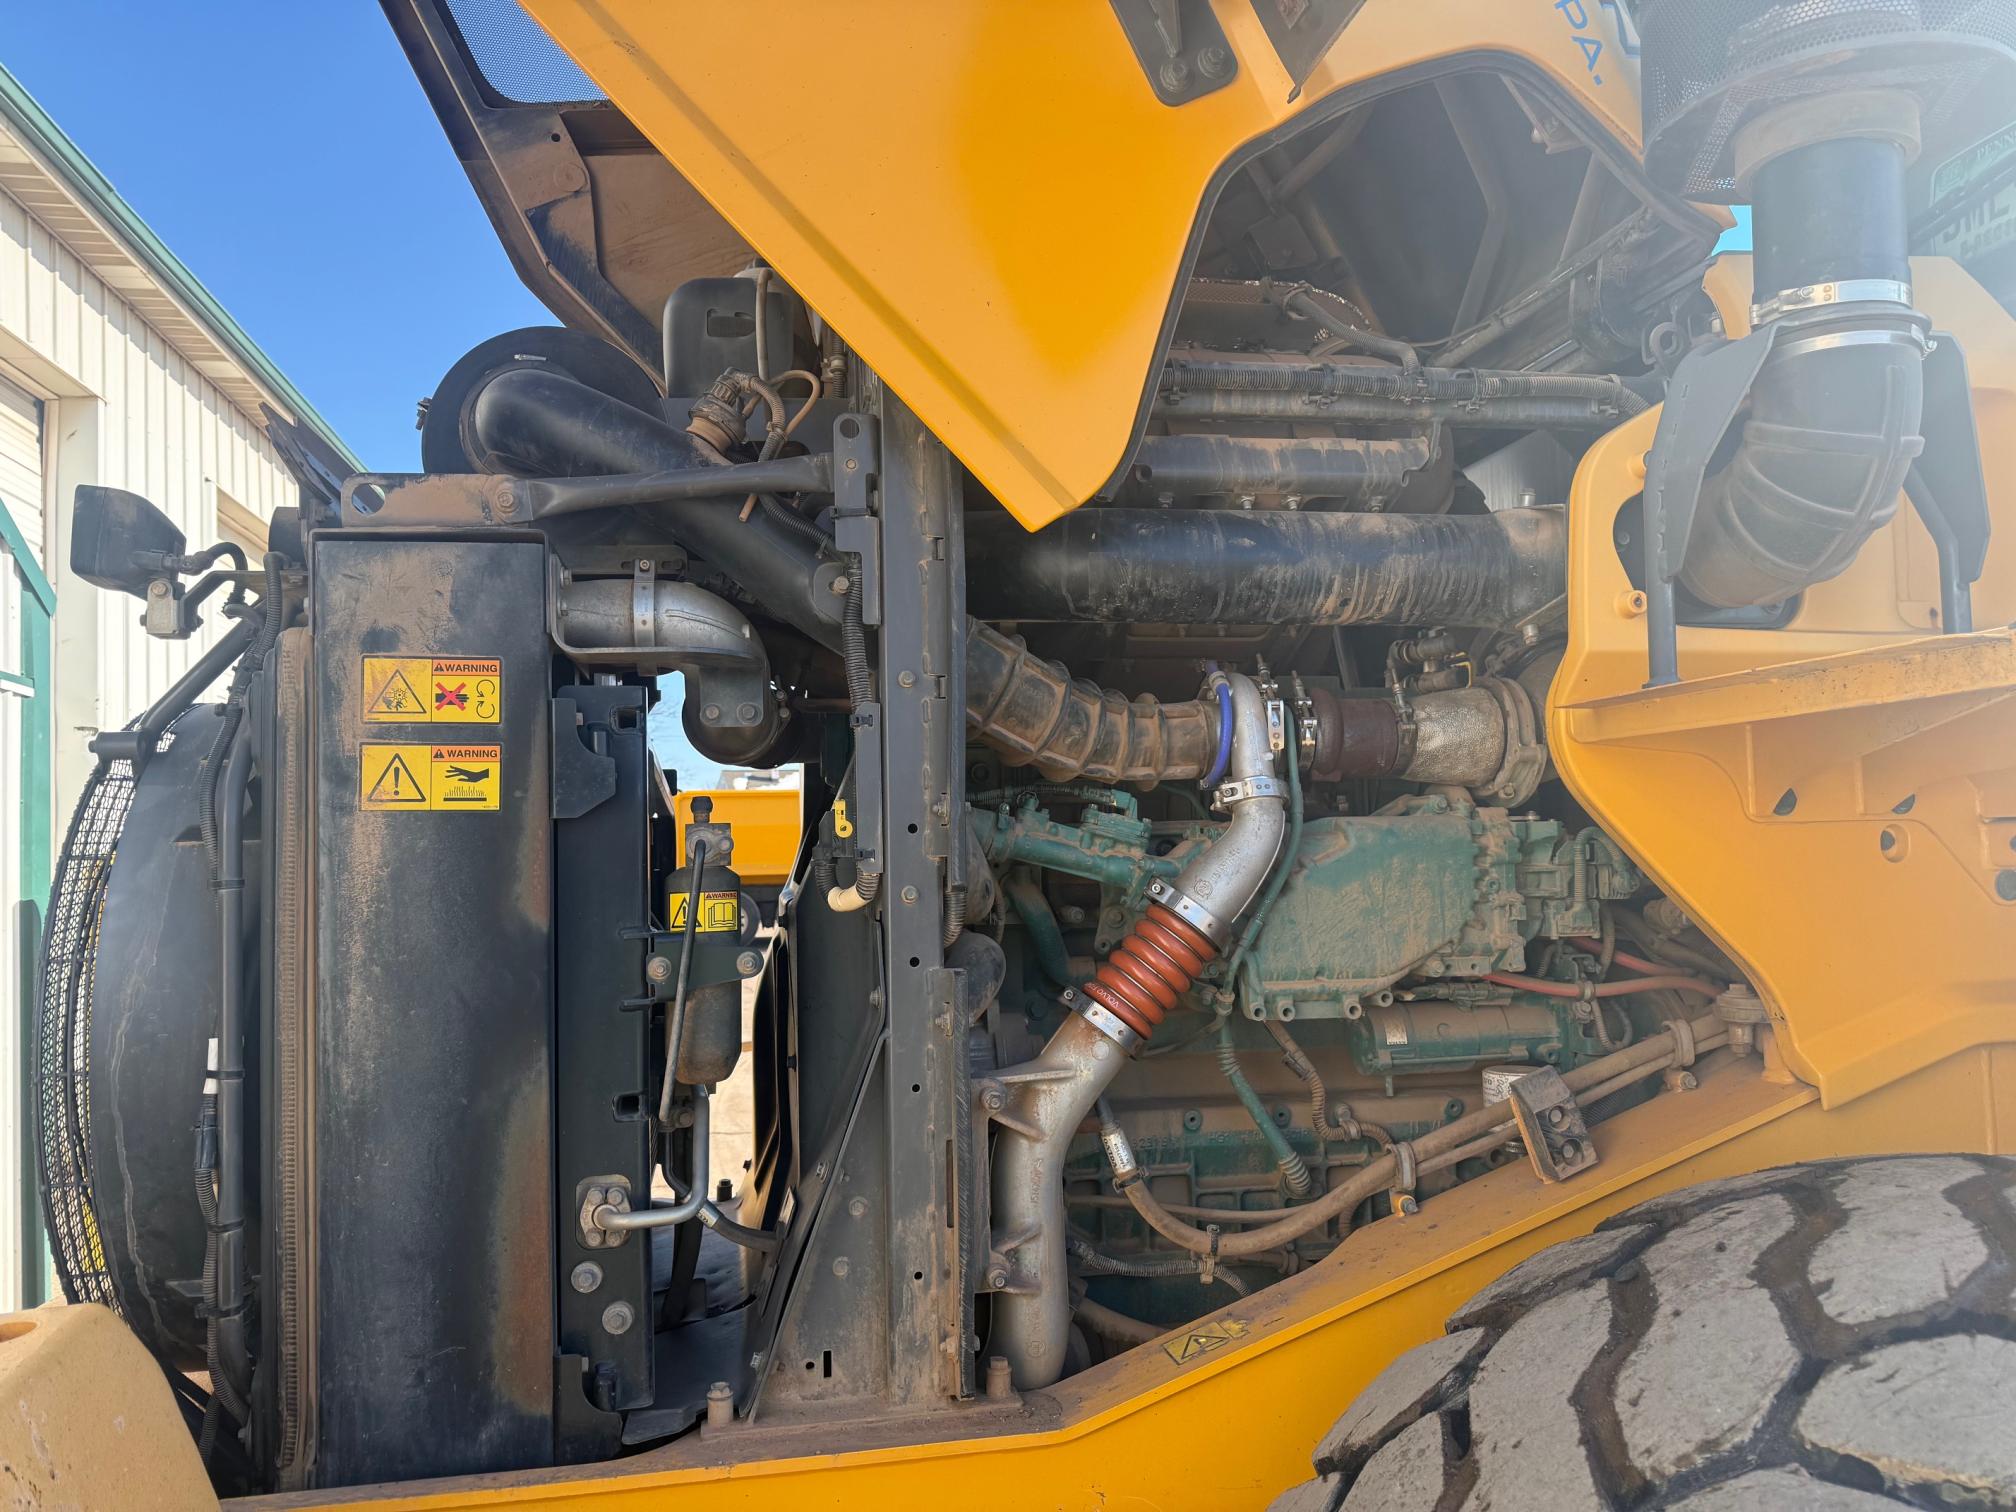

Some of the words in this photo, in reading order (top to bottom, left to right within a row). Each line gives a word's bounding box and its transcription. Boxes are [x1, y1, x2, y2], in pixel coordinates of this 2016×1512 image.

[1976, 130, 2016, 161] PENN
[445, 664, 498, 673] WARNING
[447, 749, 498, 758] WARNING
[1096, 987, 1120, 1009] VOLVO
[1103, 1137, 1118, 1169] VOLVO
